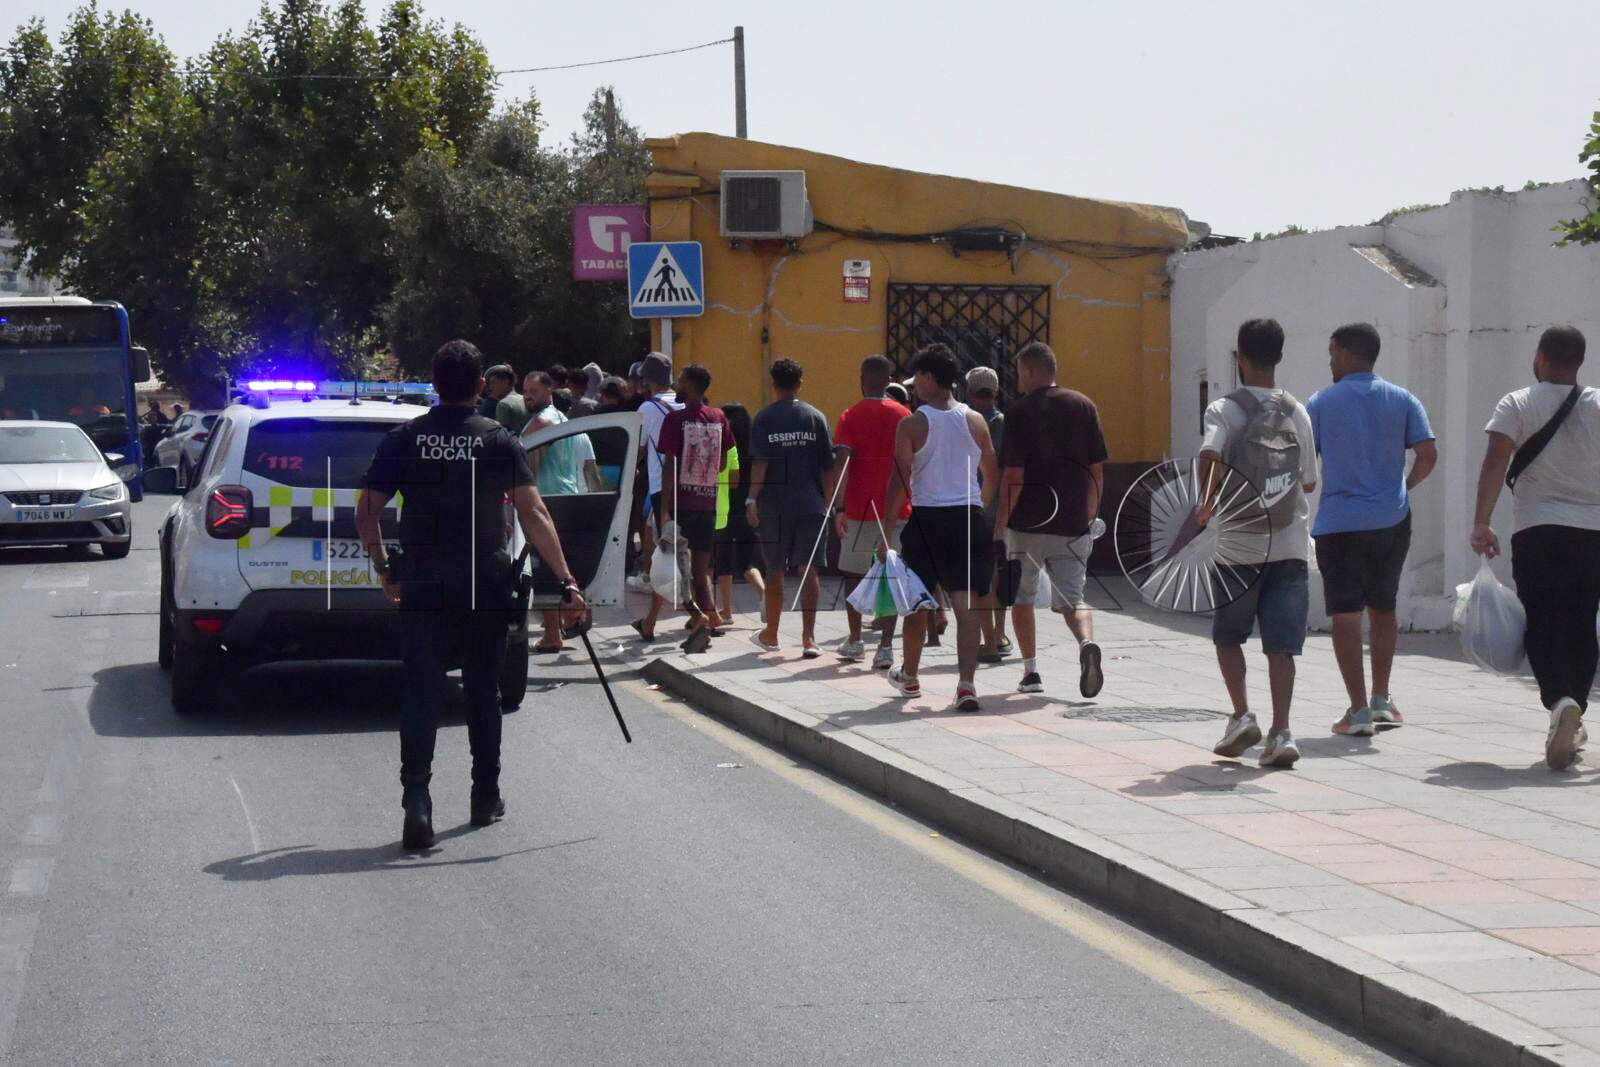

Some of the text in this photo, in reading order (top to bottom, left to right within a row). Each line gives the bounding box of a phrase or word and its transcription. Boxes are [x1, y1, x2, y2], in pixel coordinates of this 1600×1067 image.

[581, 259, 629, 270] TABAC
[416, 434, 484, 448] POLICIA
[421, 446, 475, 460] LOCAL
[267, 455, 304, 470] 112
[1265, 472, 1292, 495] NIKE
[290, 568, 371, 585] POLICÍA
